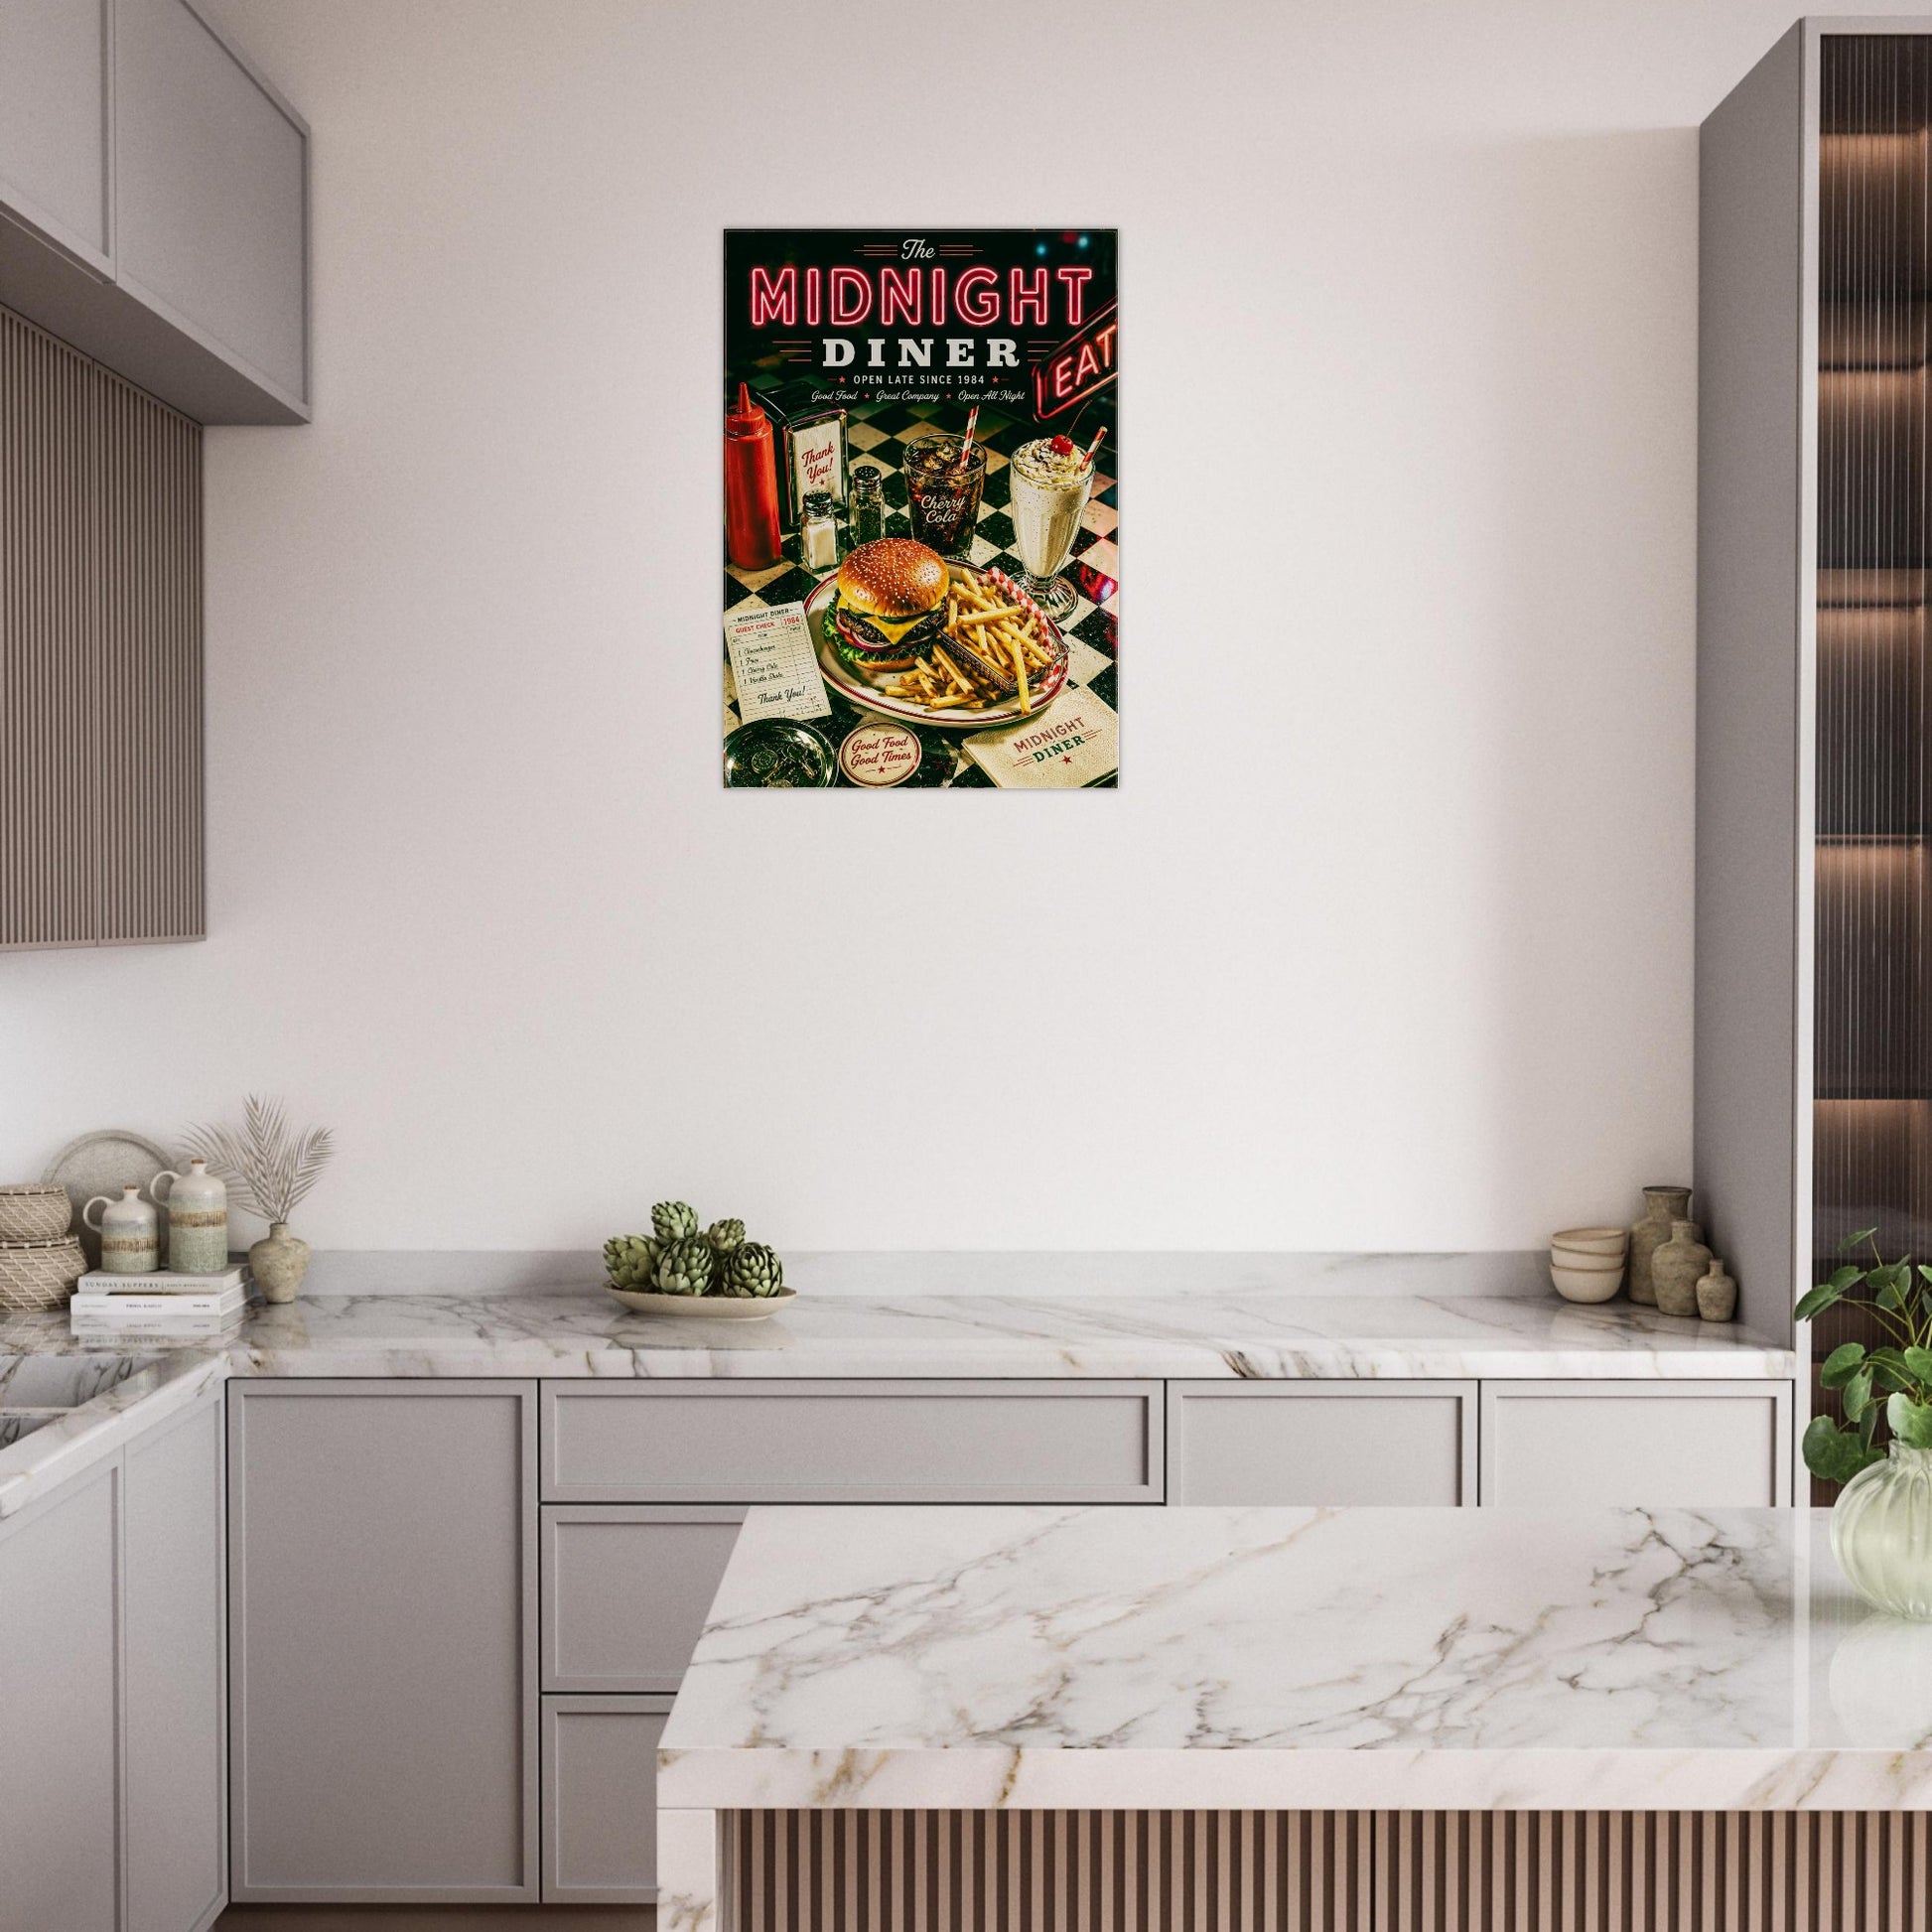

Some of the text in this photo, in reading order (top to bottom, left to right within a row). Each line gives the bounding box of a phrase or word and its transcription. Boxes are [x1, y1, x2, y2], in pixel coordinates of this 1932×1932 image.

[900, 238, 935, 260] The
[751, 266, 1093, 328] MIDNIGHT
[822, 339, 1020, 367] DINER
[1054, 323, 1117, 398] EAT
[853, 374, 985, 384] OPEN LATE SINCE 1984
[810, 389, 1026, 403] Good Food Great Company Open All Night
[801, 441, 835, 468] Thank
[806, 457, 833, 484] You!
[920, 494, 966, 512] Cherry
[925, 509, 958, 524] Cola
[735, 616, 800, 633] GUEST CHECK 1984
[737, 608, 789, 622] MIDNIGHT DINER
[758, 685, 806, 705] Thank You!
[1014, 717, 1085, 753] MIDNIGHT
[852, 736, 908, 755] Good Food
[1033, 736, 1085, 762] DINER
[851, 750, 911, 769] Good Times
